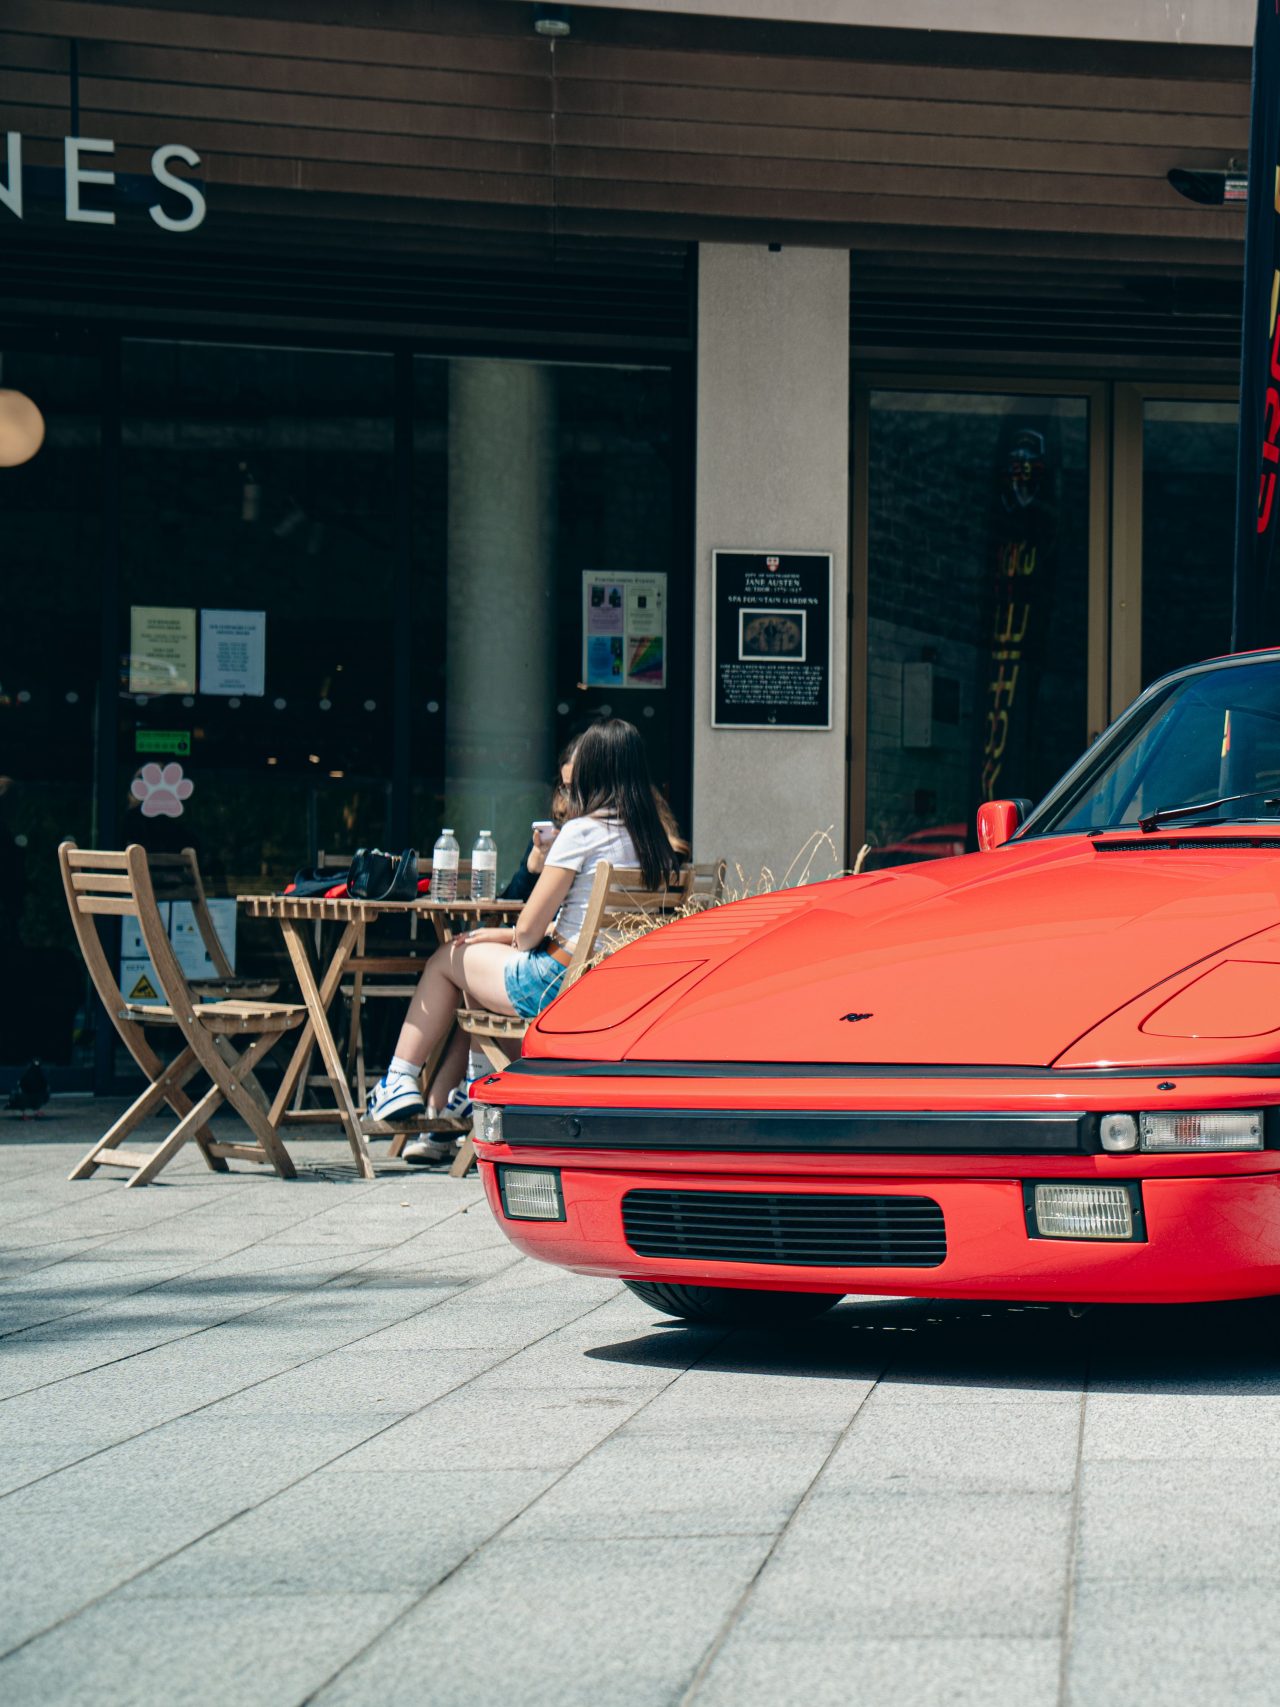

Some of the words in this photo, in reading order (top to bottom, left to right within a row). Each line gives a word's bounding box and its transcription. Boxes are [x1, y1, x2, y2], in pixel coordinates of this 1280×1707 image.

[0, 131, 206, 232] ES
[745, 578, 766, 586] JANE
[768, 578, 801, 587] AUSTEN
